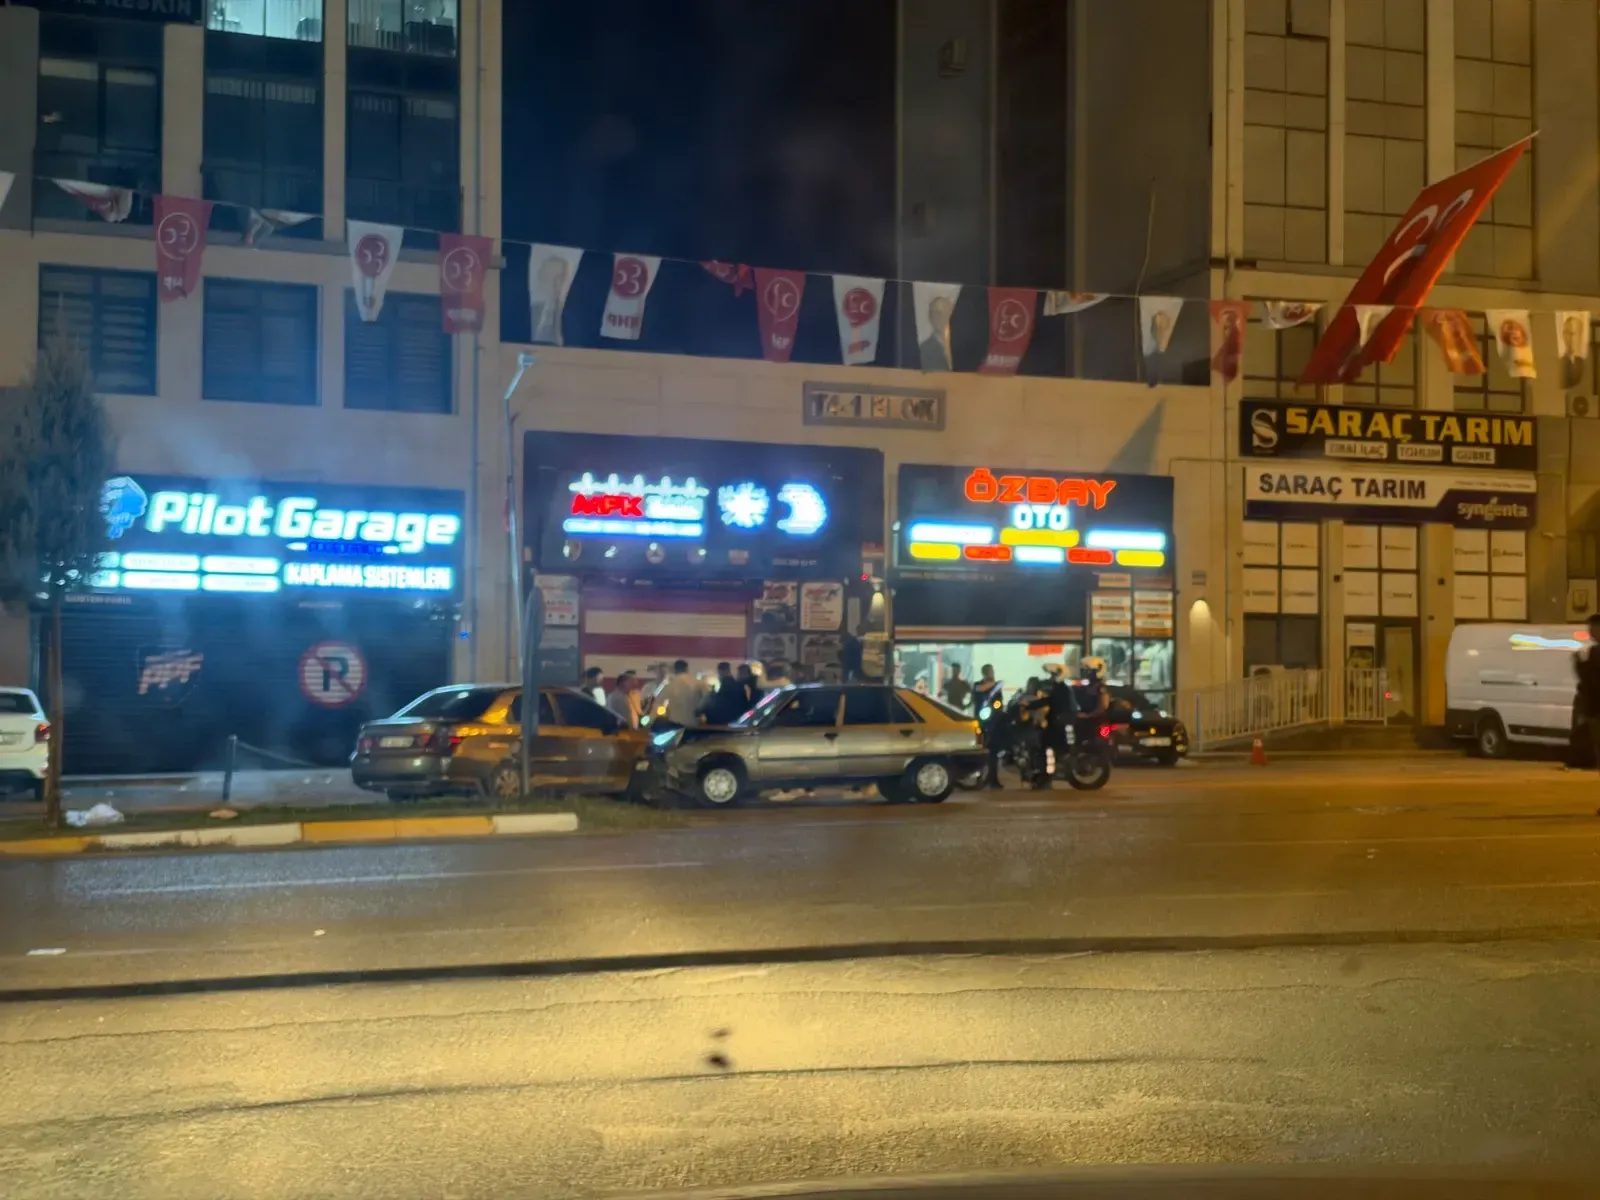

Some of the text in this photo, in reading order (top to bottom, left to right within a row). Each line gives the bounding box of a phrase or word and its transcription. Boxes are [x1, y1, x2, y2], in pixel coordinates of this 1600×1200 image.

[1286, 407, 1533, 446] SARAÇ TARIM
[964, 468, 1116, 509] ÖZBAY
[1259, 473, 1426, 500] SARAÇ TARIM
[146, 490, 460, 553] Pilot Garage
[1013, 505, 1069, 531] OTO
[1458, 498, 1528, 521] syngenta
[285, 563, 362, 586] KAPLAMA
